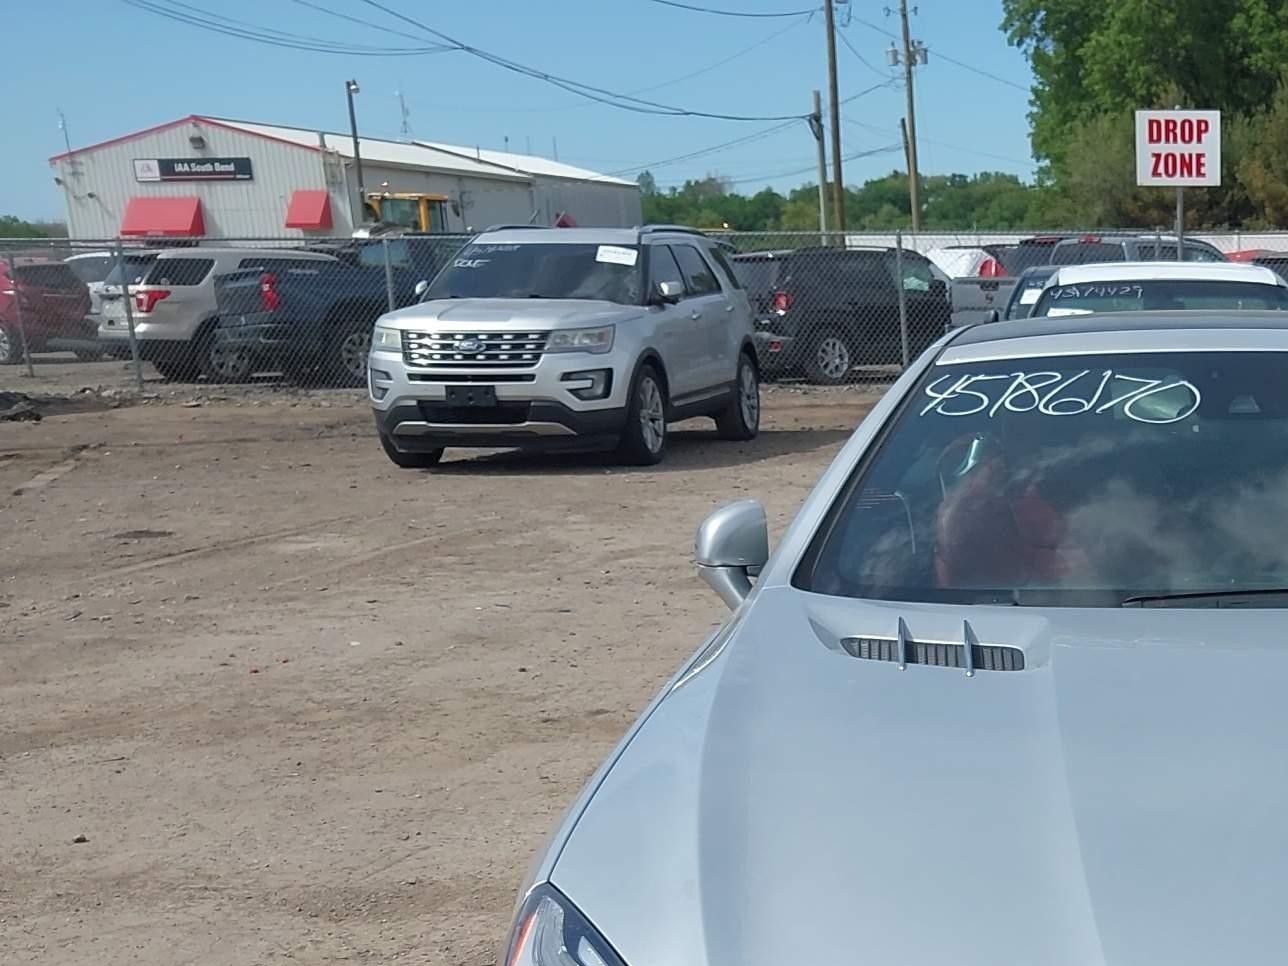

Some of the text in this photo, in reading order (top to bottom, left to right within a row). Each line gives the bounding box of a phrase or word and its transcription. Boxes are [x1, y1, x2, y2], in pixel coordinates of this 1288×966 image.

[1147, 119, 1209, 144] DROP
[174, 161, 235, 172] IAA South Bend
[1151, 153, 1206, 178] ZONE
